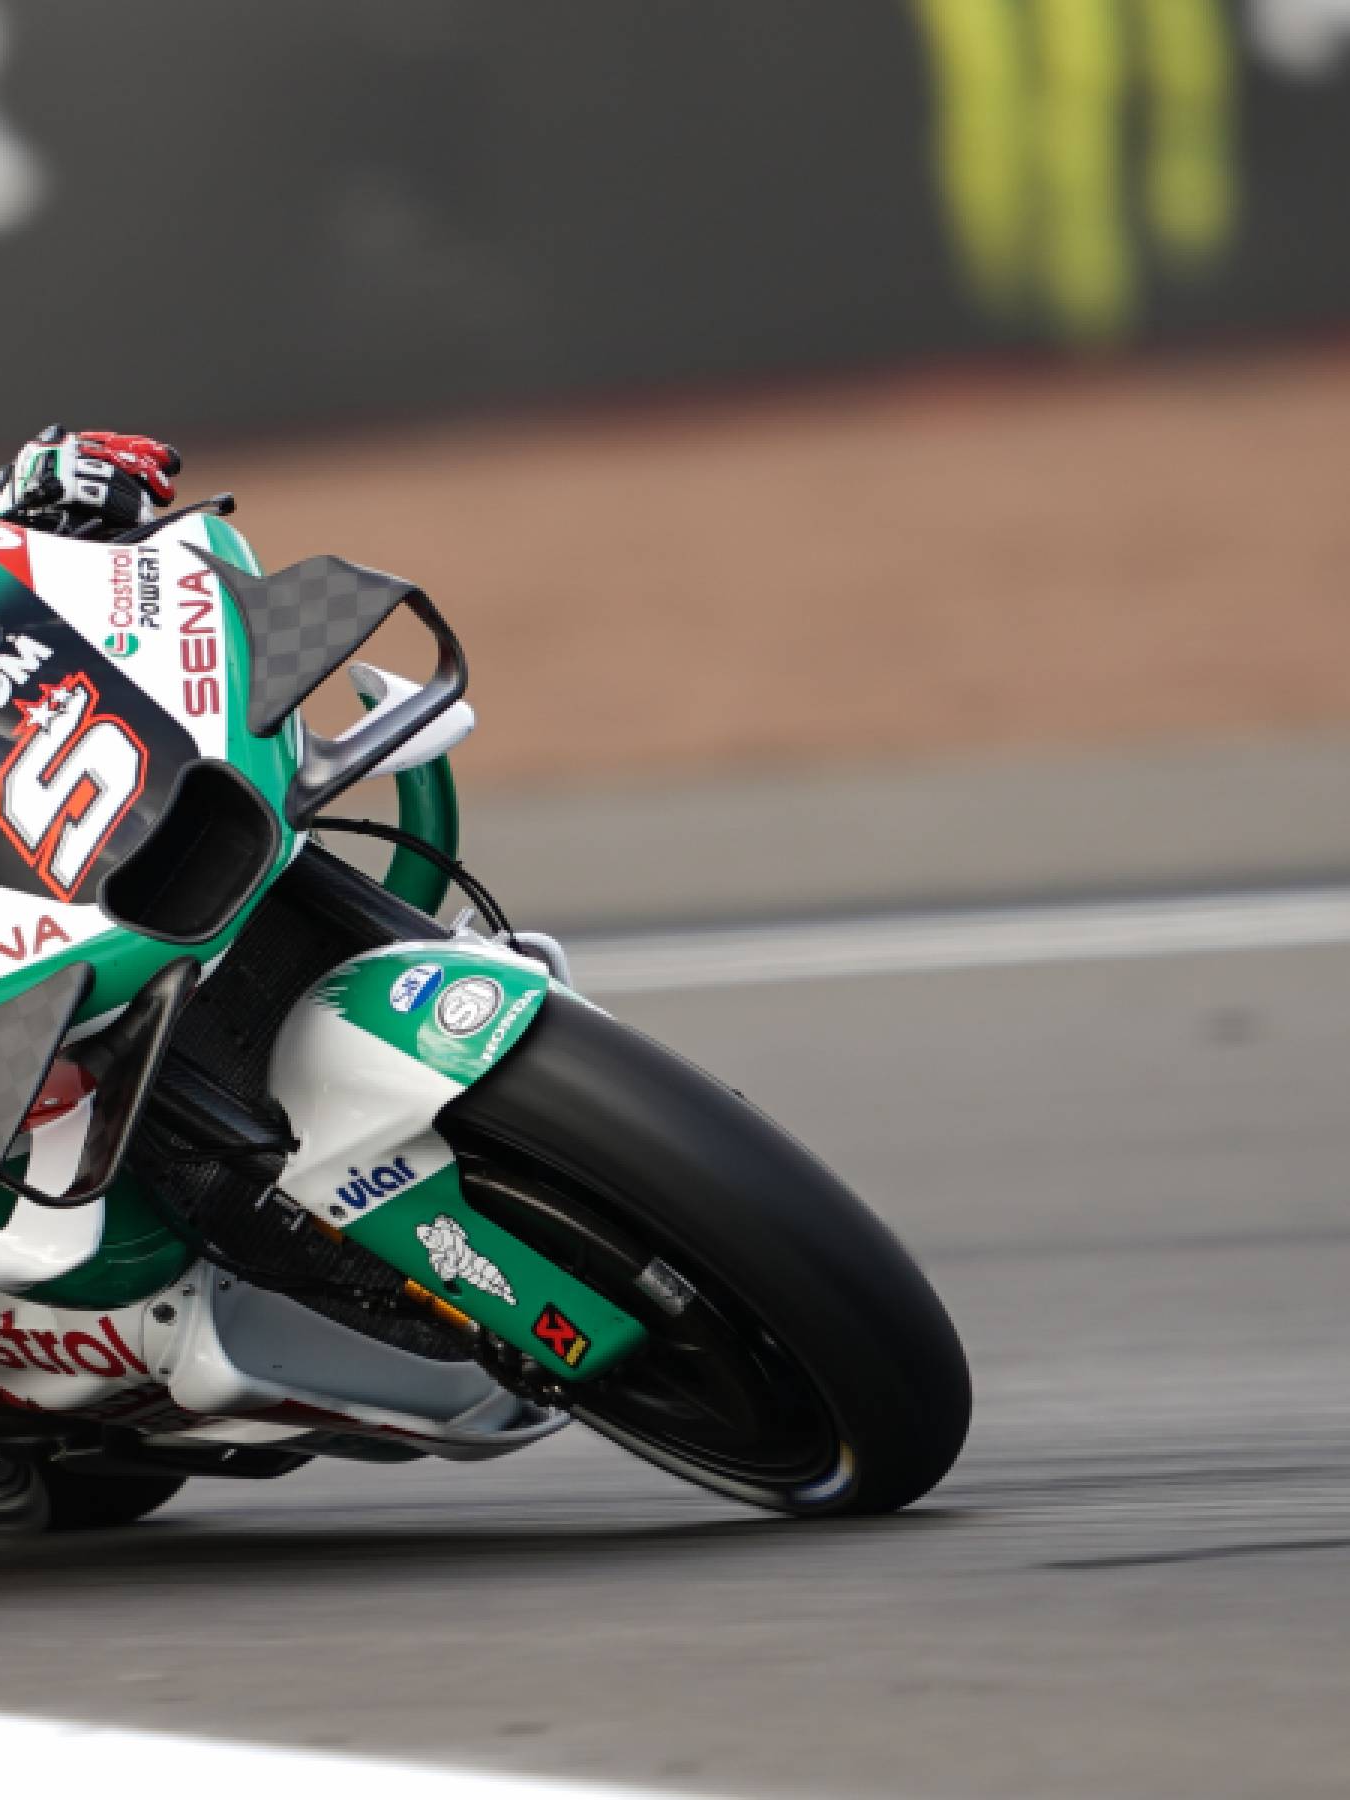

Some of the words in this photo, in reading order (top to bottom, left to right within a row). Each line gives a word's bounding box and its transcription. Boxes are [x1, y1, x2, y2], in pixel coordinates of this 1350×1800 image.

[107, 546, 133, 629] Castrol
[138, 543, 162, 631] POWER1
[176, 567, 221, 717] SENA
[480, 988, 542, 1062] HONDA
[335, 1157, 418, 1211] viar
